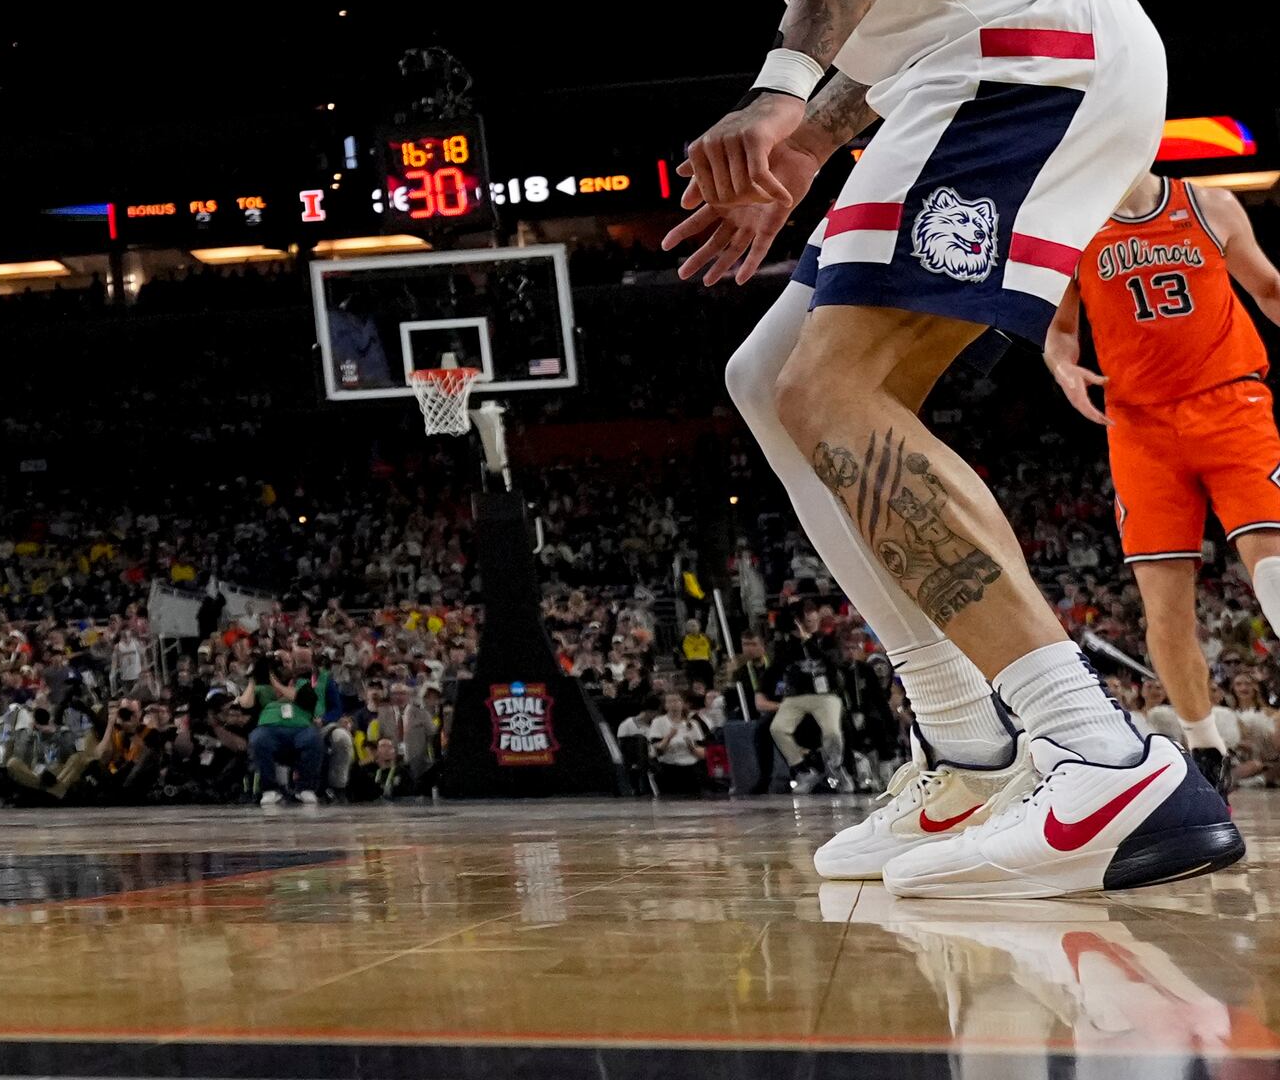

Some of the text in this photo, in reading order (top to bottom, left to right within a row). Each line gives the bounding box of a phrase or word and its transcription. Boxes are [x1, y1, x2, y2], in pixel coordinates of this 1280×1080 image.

[405, 168, 466, 219] 30
[579, 175, 630, 192] 2ND
[127, 203, 176, 217] BONUS
[190, 200, 217, 214] FLS
[237, 196, 266, 209] TOL
[1098, 237, 1204, 281] Illinois
[1127, 272, 1194, 321] 13
[494, 698, 546, 716] FINAL
[500, 735, 550, 753] FOUR
